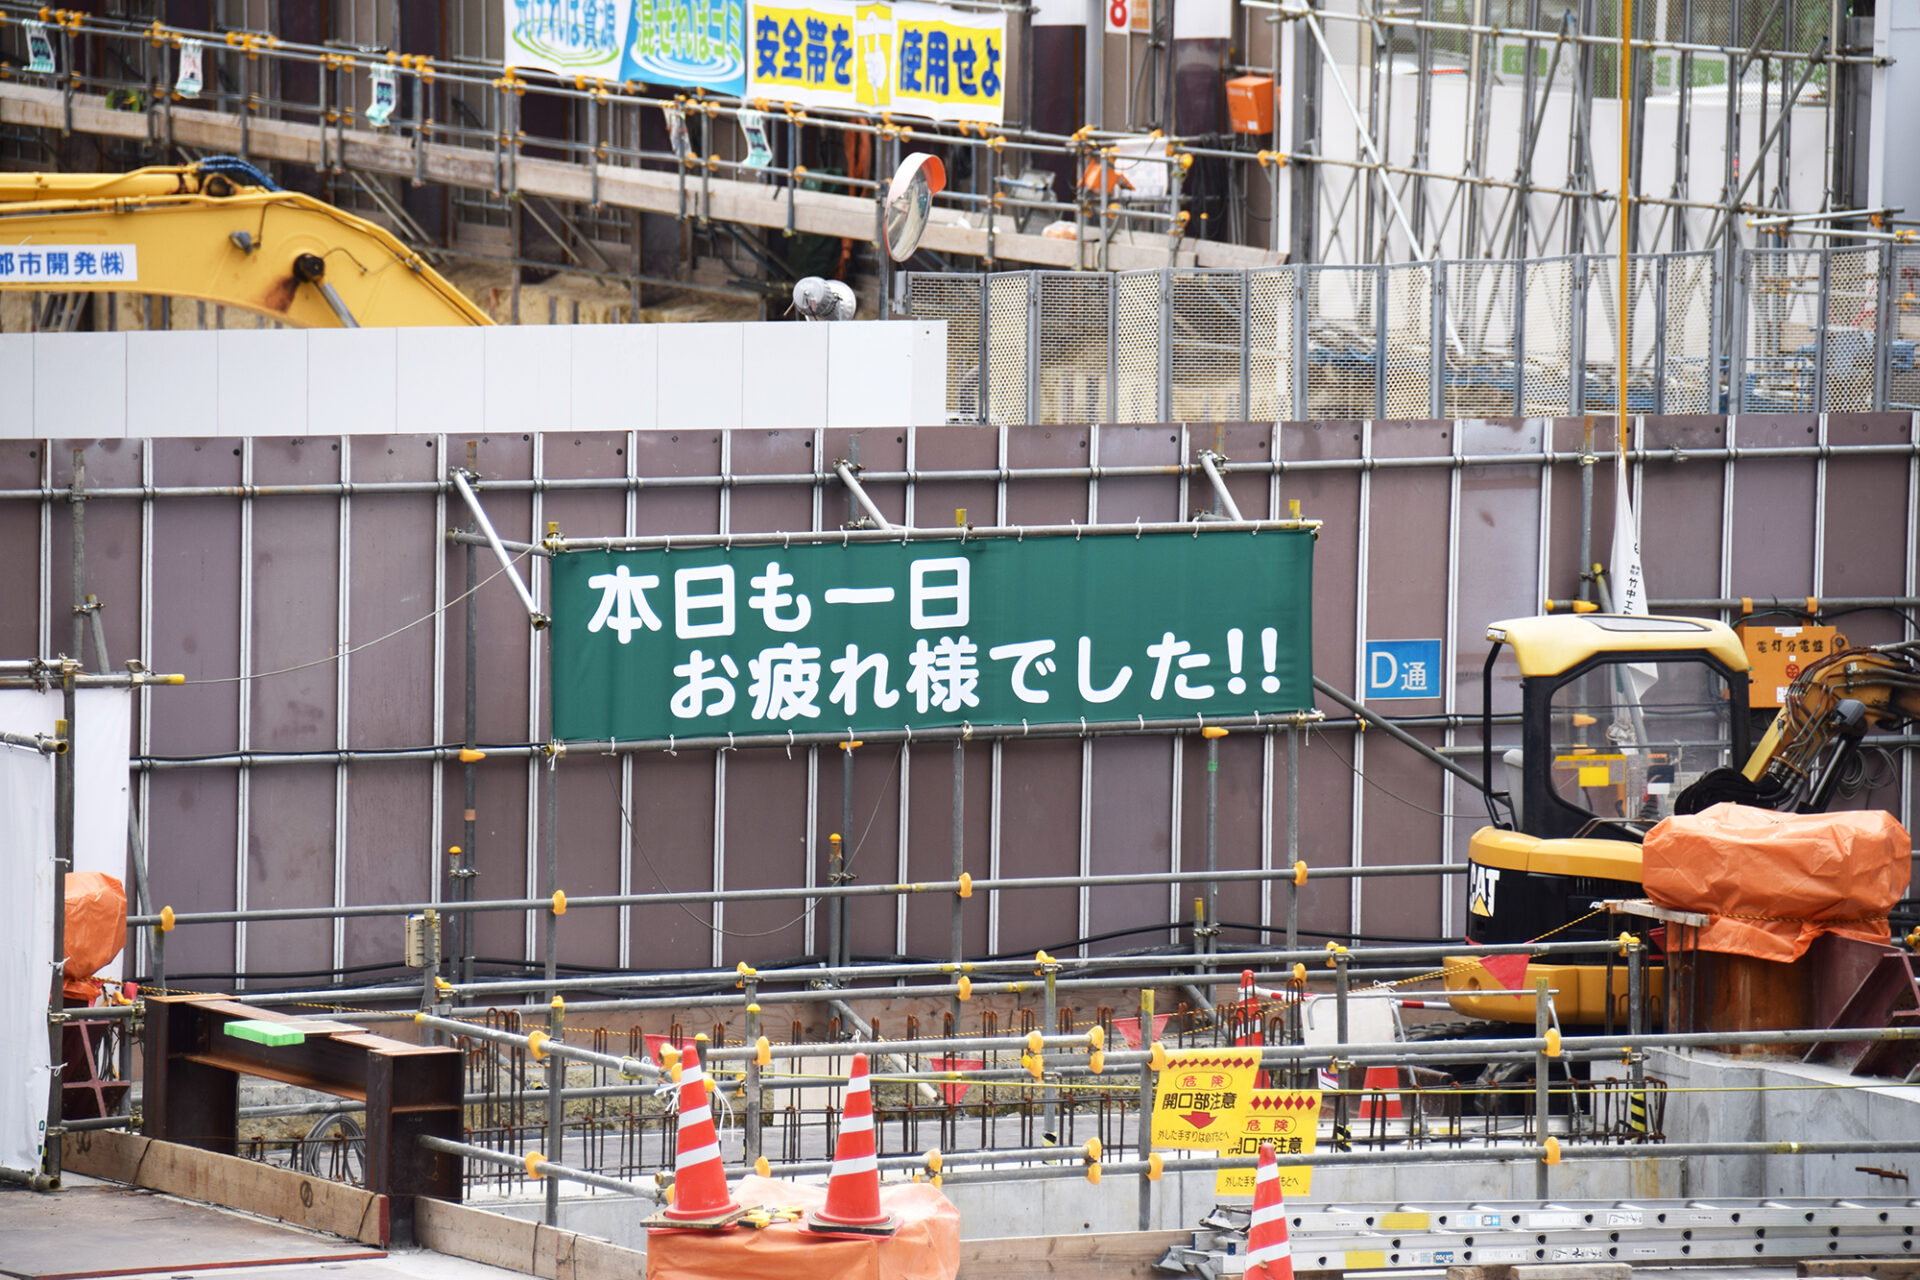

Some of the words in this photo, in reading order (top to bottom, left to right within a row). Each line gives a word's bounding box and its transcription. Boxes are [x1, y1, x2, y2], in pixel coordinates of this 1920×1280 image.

[756, 15, 853, 85] 安全帯を
[900, 28, 1001, 97] 使用せよ
[587, 557, 970, 644] 本日も一日
[670, 627, 1281, 720] お疲れ様でした!!
[1470, 863, 1500, 917] CAT
[1162, 1092, 1237, 1110] 開口部注意
